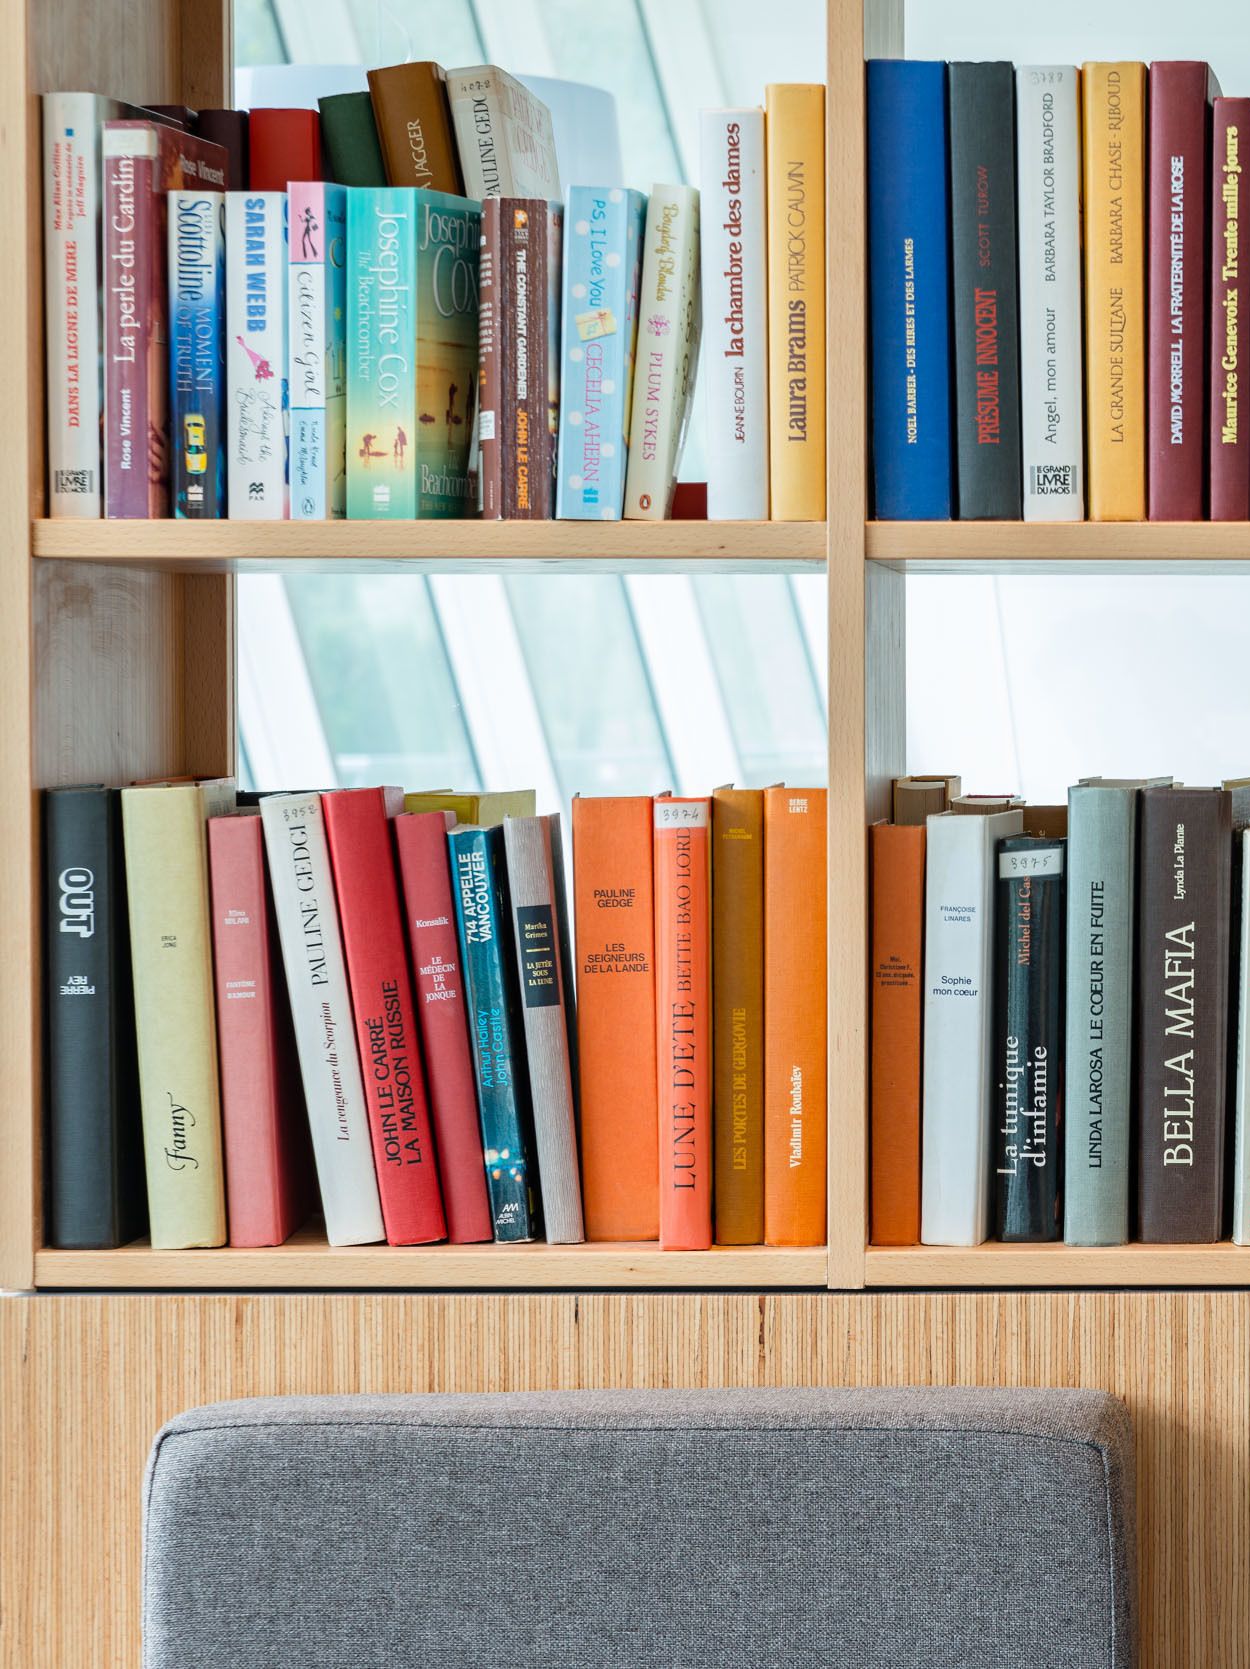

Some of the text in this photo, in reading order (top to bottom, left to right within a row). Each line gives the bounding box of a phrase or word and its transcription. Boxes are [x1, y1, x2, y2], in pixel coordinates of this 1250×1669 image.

[1042, 93, 1055, 282] BARBARA TAYLOR BRADFORD
[1222, 126, 1243, 280] Trente mille jours
[178, 199, 211, 301] Scottoline
[246, 198, 265, 331] SARAH WEBB
[723, 123, 744, 358] la chambre des dames
[64, 240, 81, 428] DANS LA LIGNE DE MIRE
[112, 240, 140, 362] La perle du
[369, 206, 410, 409] Josephine Cox
[904, 238, 916, 368] DES RIRES ET DES LARMES
[975, 288, 998, 365] INNOCENT
[178, 306, 192, 391] OF TRUTH
[197, 306, 213, 392] MOMENT
[786, 300, 809, 442] Laura Brams
[1044, 307, 1060, 444] Angel, mon amour
[1222, 289, 1238, 444] Maurice Genevoix
[120, 388, 132, 469] Rose Vincent
[907, 375, 917, 444] NOEL BARBER
[59, 867, 94, 937] OUT
[459, 853, 480, 944] 714 APPELLE
[472, 851, 493, 943] VANCOUVER
[594, 889, 636, 899] PAULINE
[1174, 824, 1185, 900] Lynda La Plante
[597, 899, 633, 909] GEDGE
[676, 885, 691, 924] BAO
[1090, 933, 1104, 956] EN
[1091, 881, 1105, 928] FUITE
[61, 985, 95, 994] PIERRE
[67, 975, 88, 984] REY
[676, 933, 692, 992] BETTE
[932, 987, 953, 995] mon
[941, 976, 973, 984] Sophie
[476, 1009, 495, 1088] Arthur Hailey
[487, 1008, 508, 1086] John Castle
[1090, 1018, 1103, 1040] LE
[1164, 922, 1195, 1167] BELLA MAFIA
[365, 1016, 403, 1167] JOHN LE CARRÉ
[382, 979, 423, 1165] LA MAISON RUSSIE
[997, 1036, 1022, 1177] La tunique
[1020, 1046, 1048, 1167] d'infamie
[1089, 1048, 1103, 1116] LAROSA
[164, 1092, 198, 1171] Fanny
[673, 1102, 696, 1191] LUNE
[789, 1119, 802, 1168] Vladimir
[1090, 1119, 1103, 1168] LINDA
